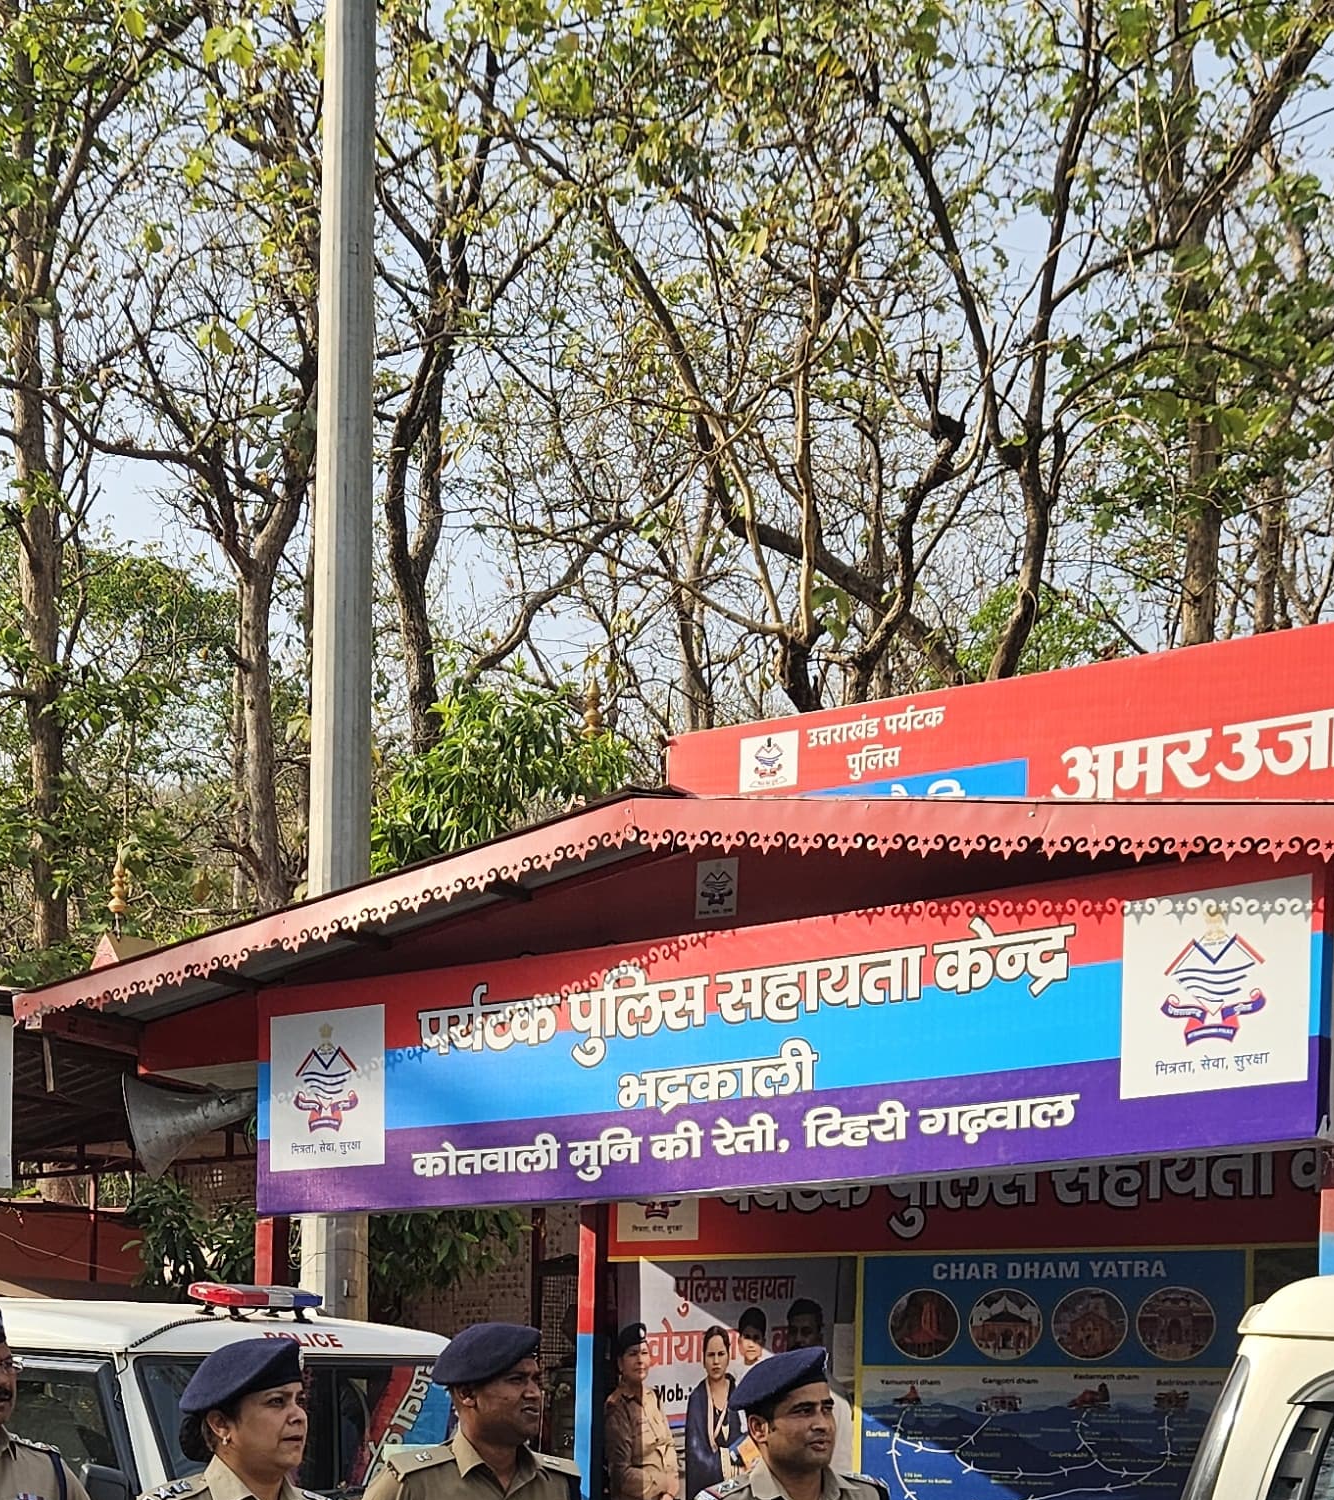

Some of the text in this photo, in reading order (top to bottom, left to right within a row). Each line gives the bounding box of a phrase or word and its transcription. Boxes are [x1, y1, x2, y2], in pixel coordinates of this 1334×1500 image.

[807, 705, 945, 748] उत्तराखंड पर्यटक
[847, 744, 901, 781] पुलिस
[1052, 729, 1210, 798] अमर
[418, 916, 1076, 1068] पर्यटक पुलिस सहायता केन्द्र
[617, 1037, 818, 1115] भद्रकाली
[1154, 1051, 1270, 1076] मित्रता, सेवा, सुरक्षा
[411, 1093, 1081, 1182] कोतवाली मुनि की रेती, टिहरी गढ़वाल
[674, 1264, 797, 1317] पुलिस सहायता
[932, 1260, 1167, 1281] CHAR DHAM YATRA
